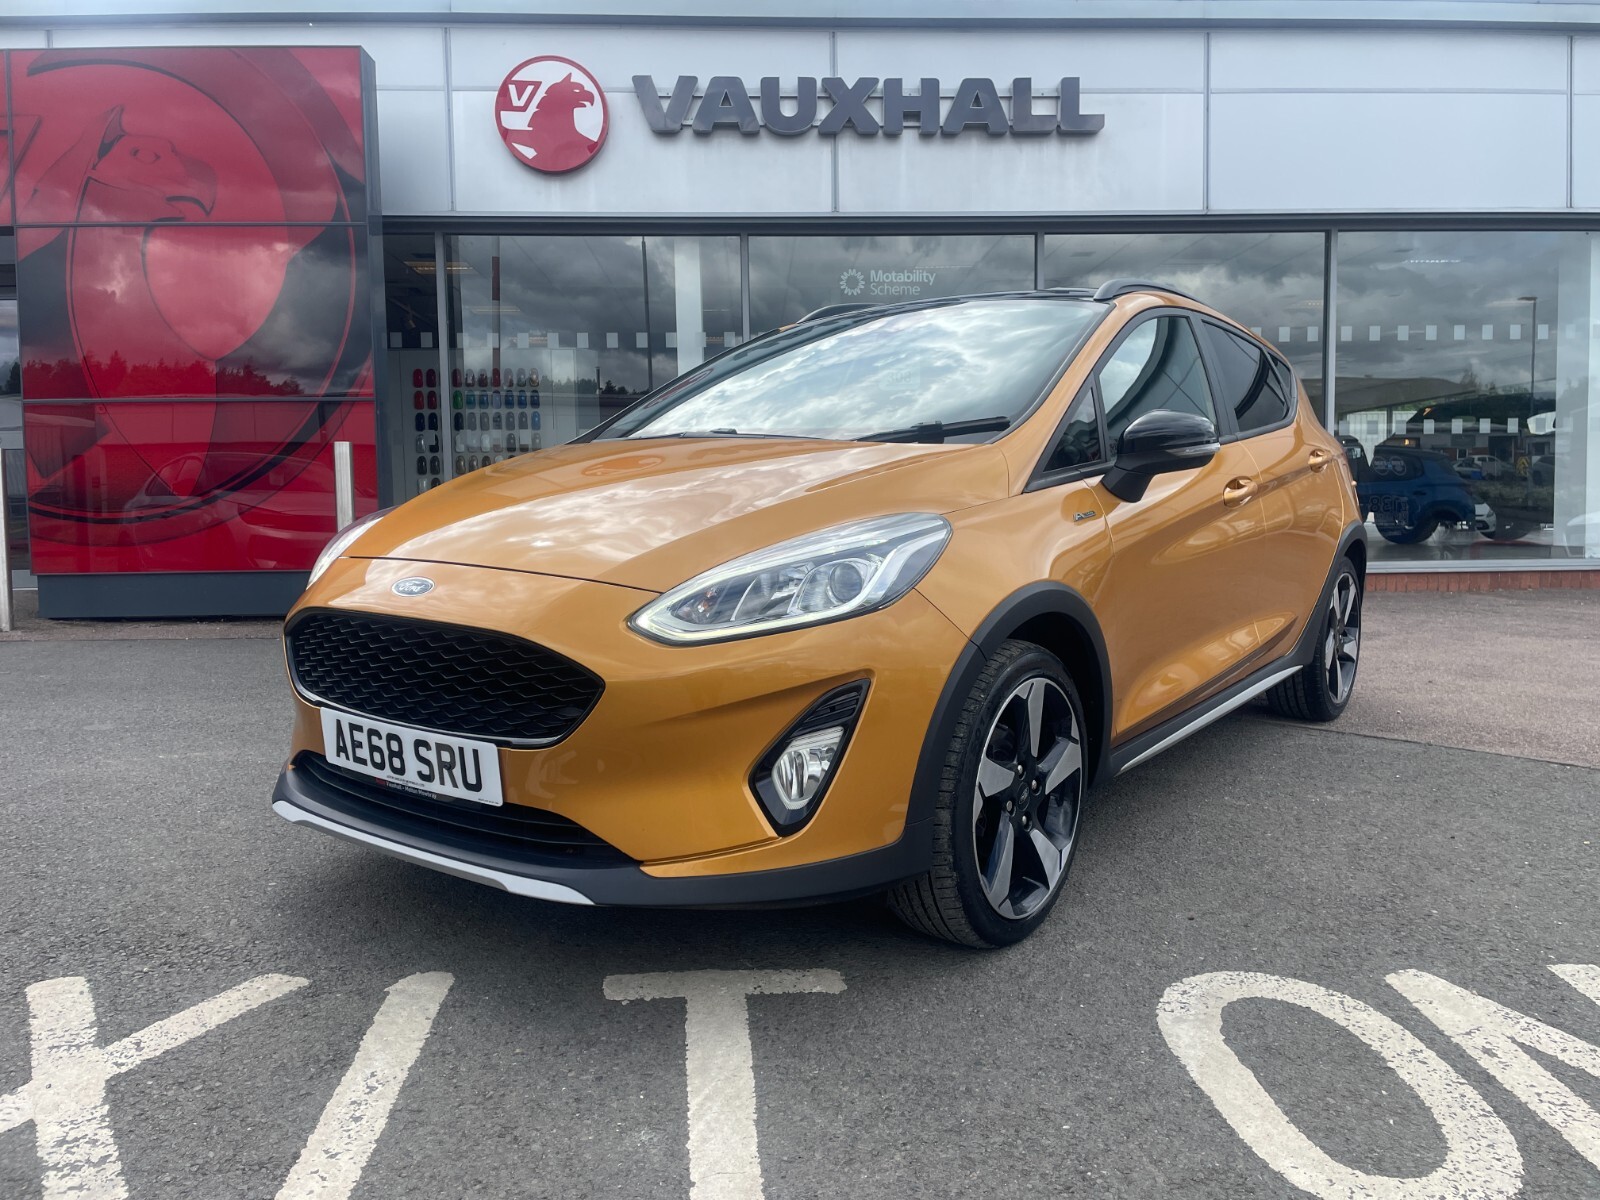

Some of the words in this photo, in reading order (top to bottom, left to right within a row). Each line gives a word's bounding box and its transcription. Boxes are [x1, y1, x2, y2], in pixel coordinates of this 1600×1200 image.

[631, 75, 1105, 135] VAUXHALL
[870, 269, 936, 286] Motability
[870, 283, 921, 295] Scheme
[336, 718, 406, 776] AE68
[413, 738, 483, 793] SRU
